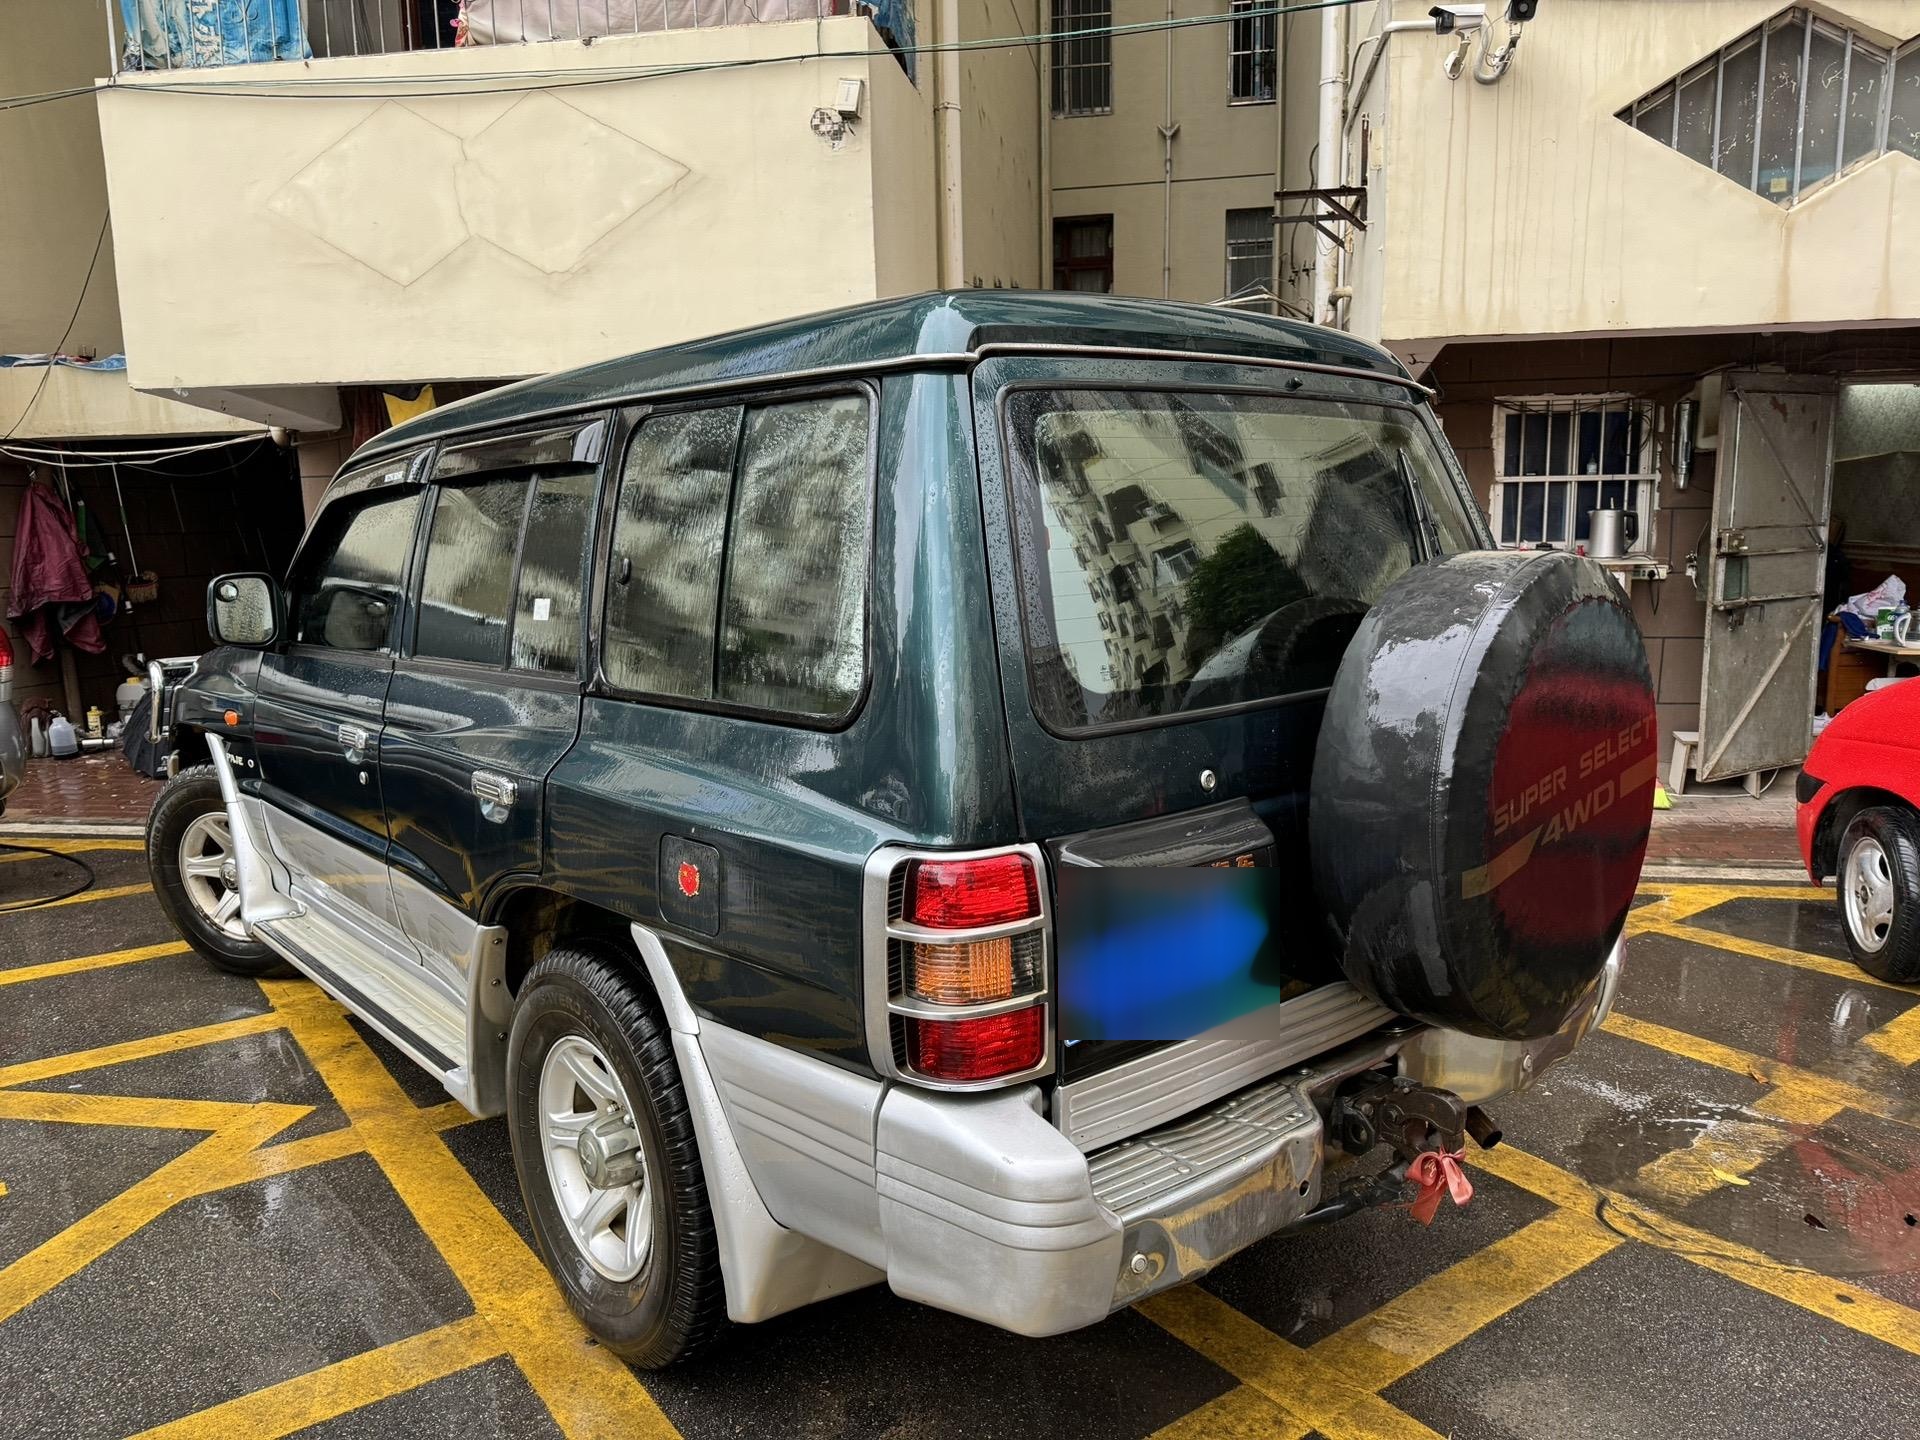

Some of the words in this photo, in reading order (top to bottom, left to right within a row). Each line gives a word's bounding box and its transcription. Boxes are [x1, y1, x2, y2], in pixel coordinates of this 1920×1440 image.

[1494, 766, 1567, 837] SUPER
[1579, 714, 1654, 779] SELECT
[1541, 780, 1615, 847] 4WD
